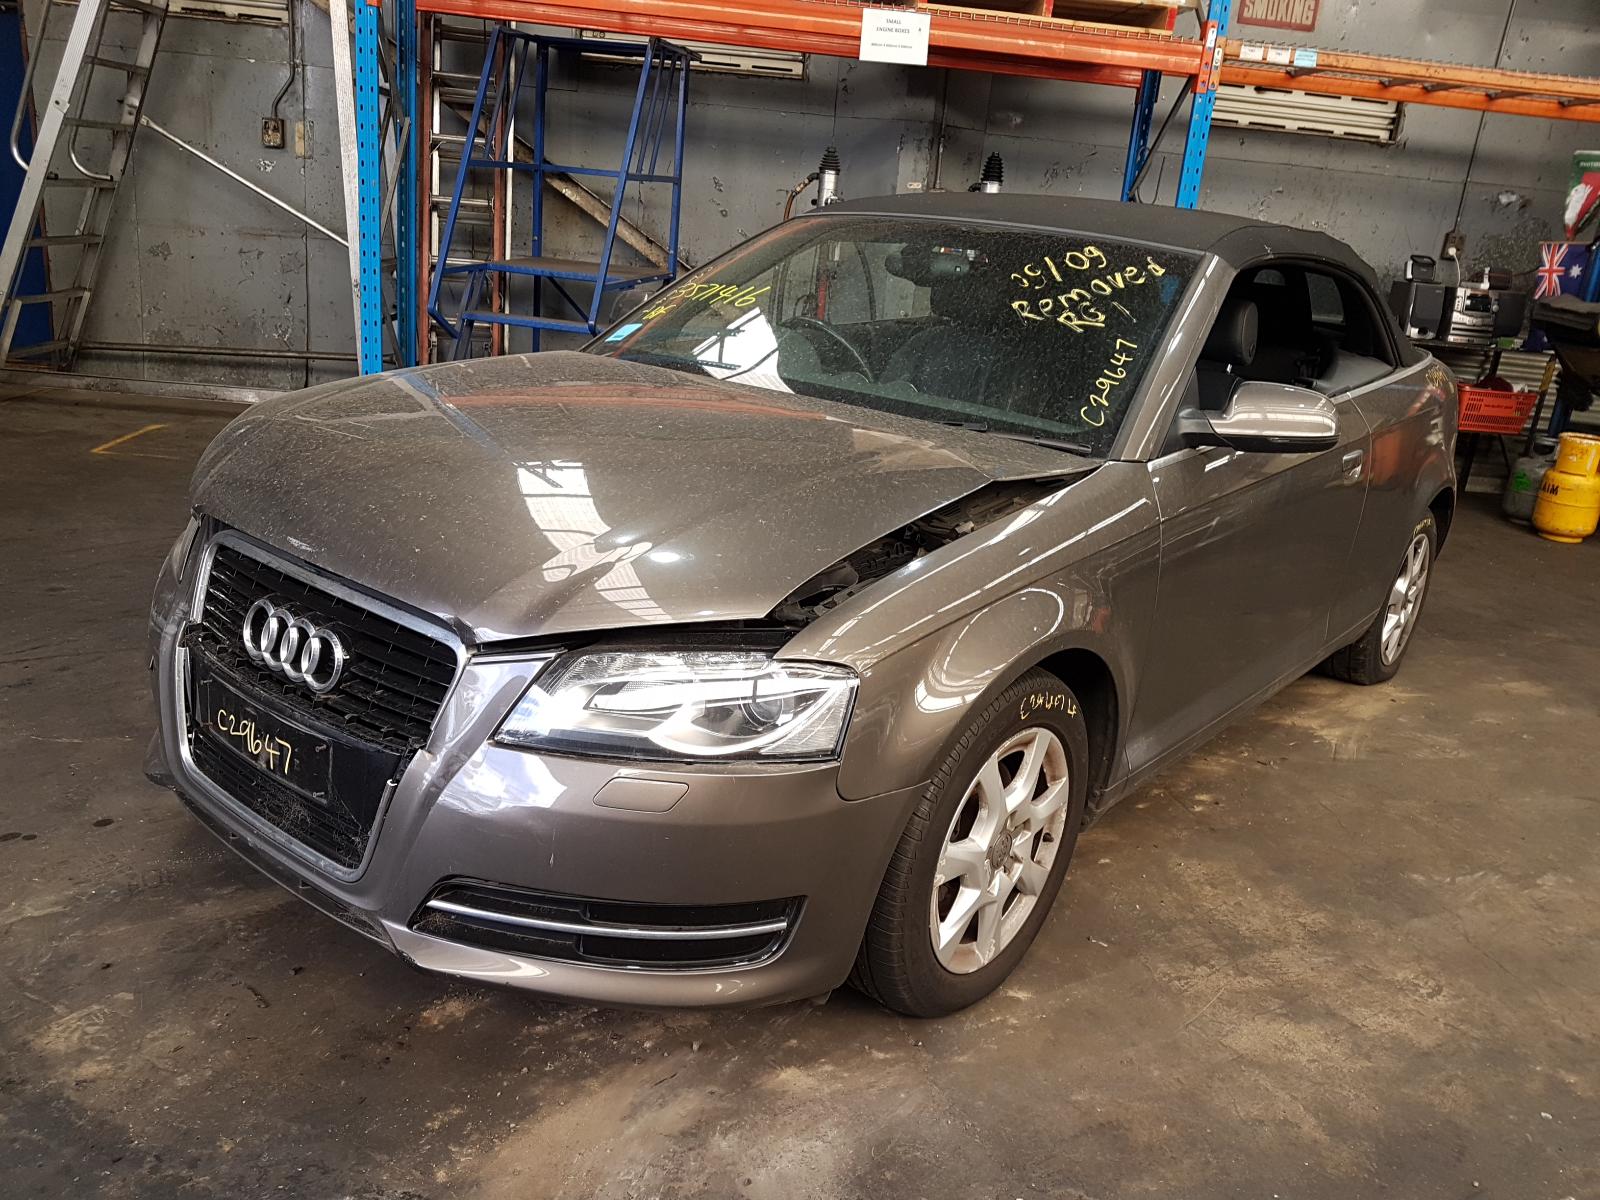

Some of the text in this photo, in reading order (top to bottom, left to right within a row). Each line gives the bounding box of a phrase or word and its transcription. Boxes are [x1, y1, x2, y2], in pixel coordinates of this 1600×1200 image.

[1243, 0, 1315, 25] SMOKING
[1011, 256, 1167, 326] Removed
[1079, 336, 1138, 428] C29647
[217, 709, 292, 775] C29647
